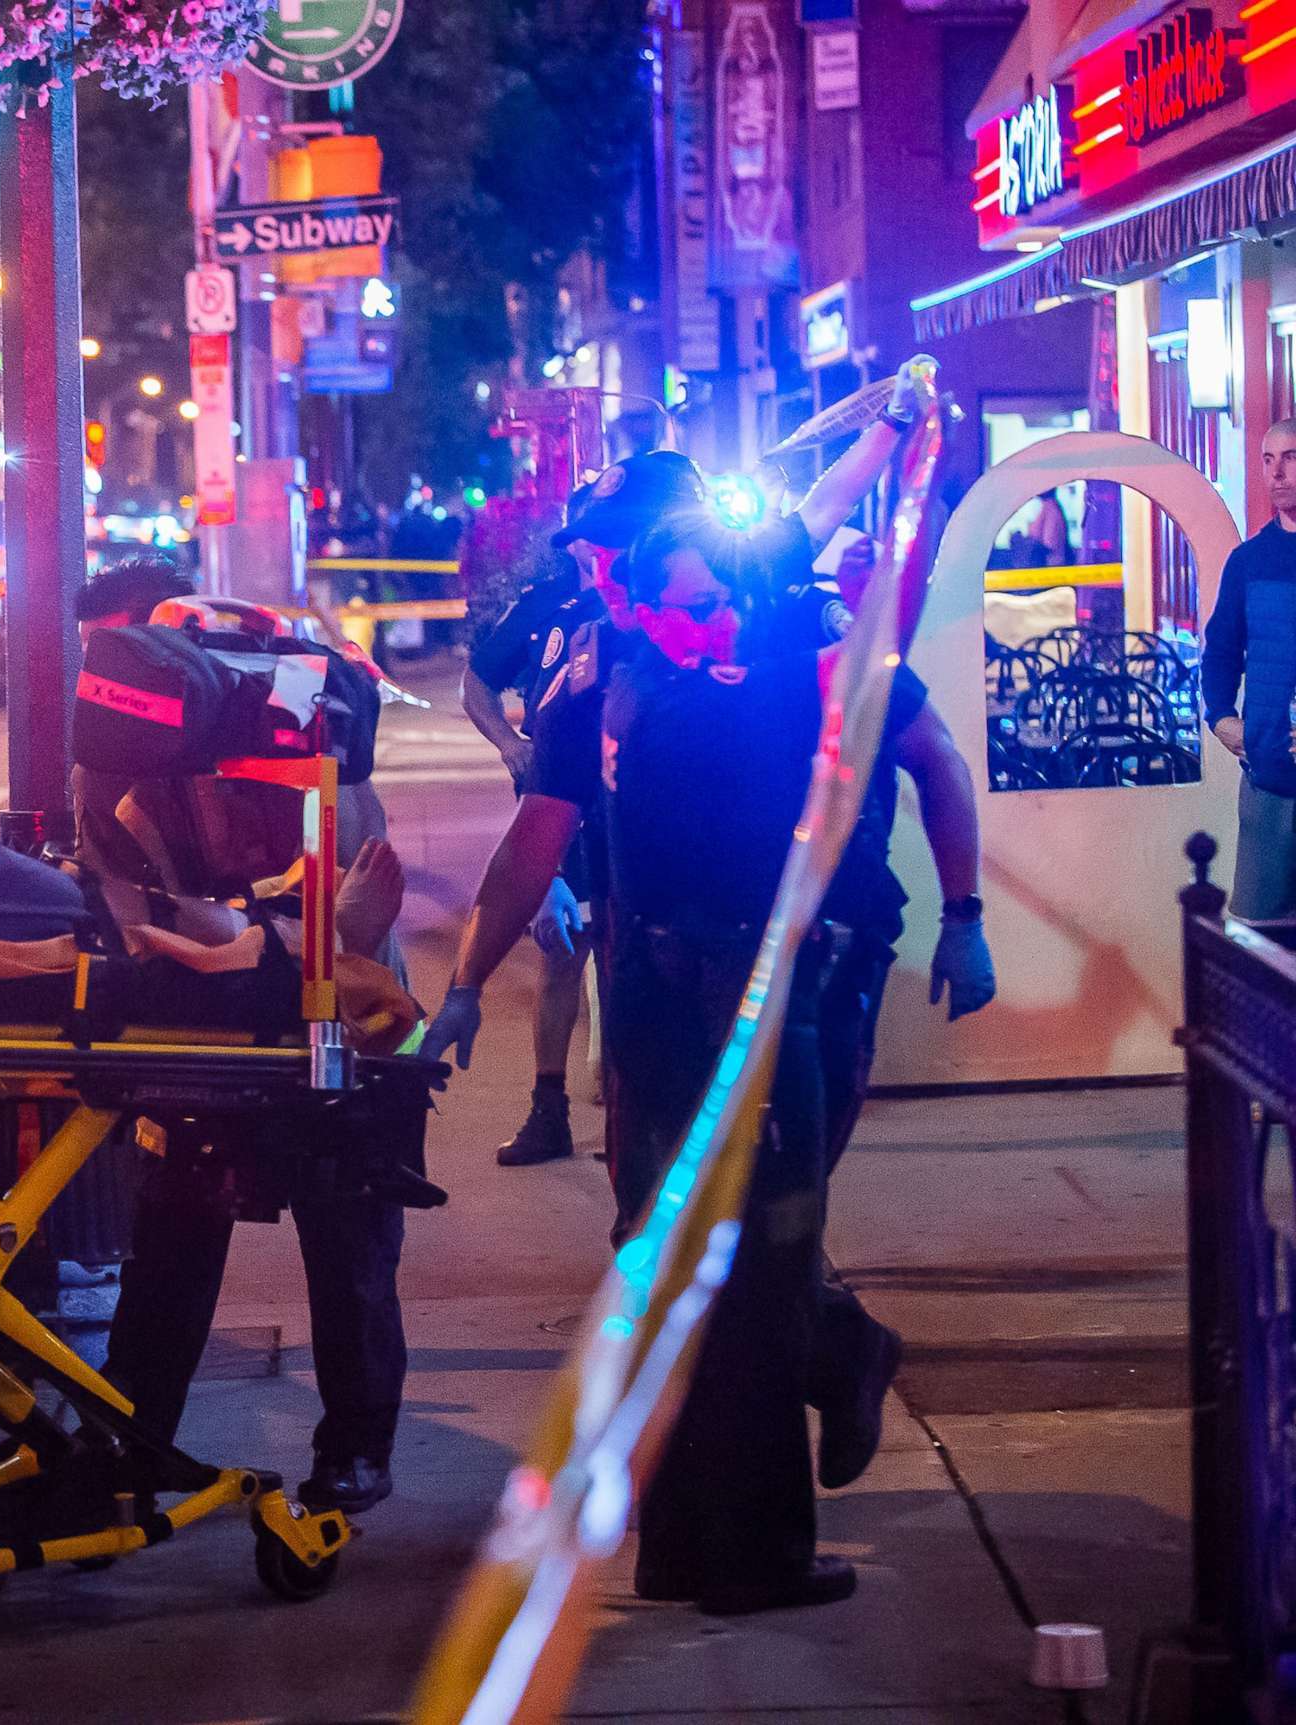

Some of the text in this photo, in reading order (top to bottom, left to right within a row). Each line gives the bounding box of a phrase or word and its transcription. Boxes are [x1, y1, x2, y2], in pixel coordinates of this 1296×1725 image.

[254, 212, 393, 251] Subway
[93, 684, 149, 712] X Series
